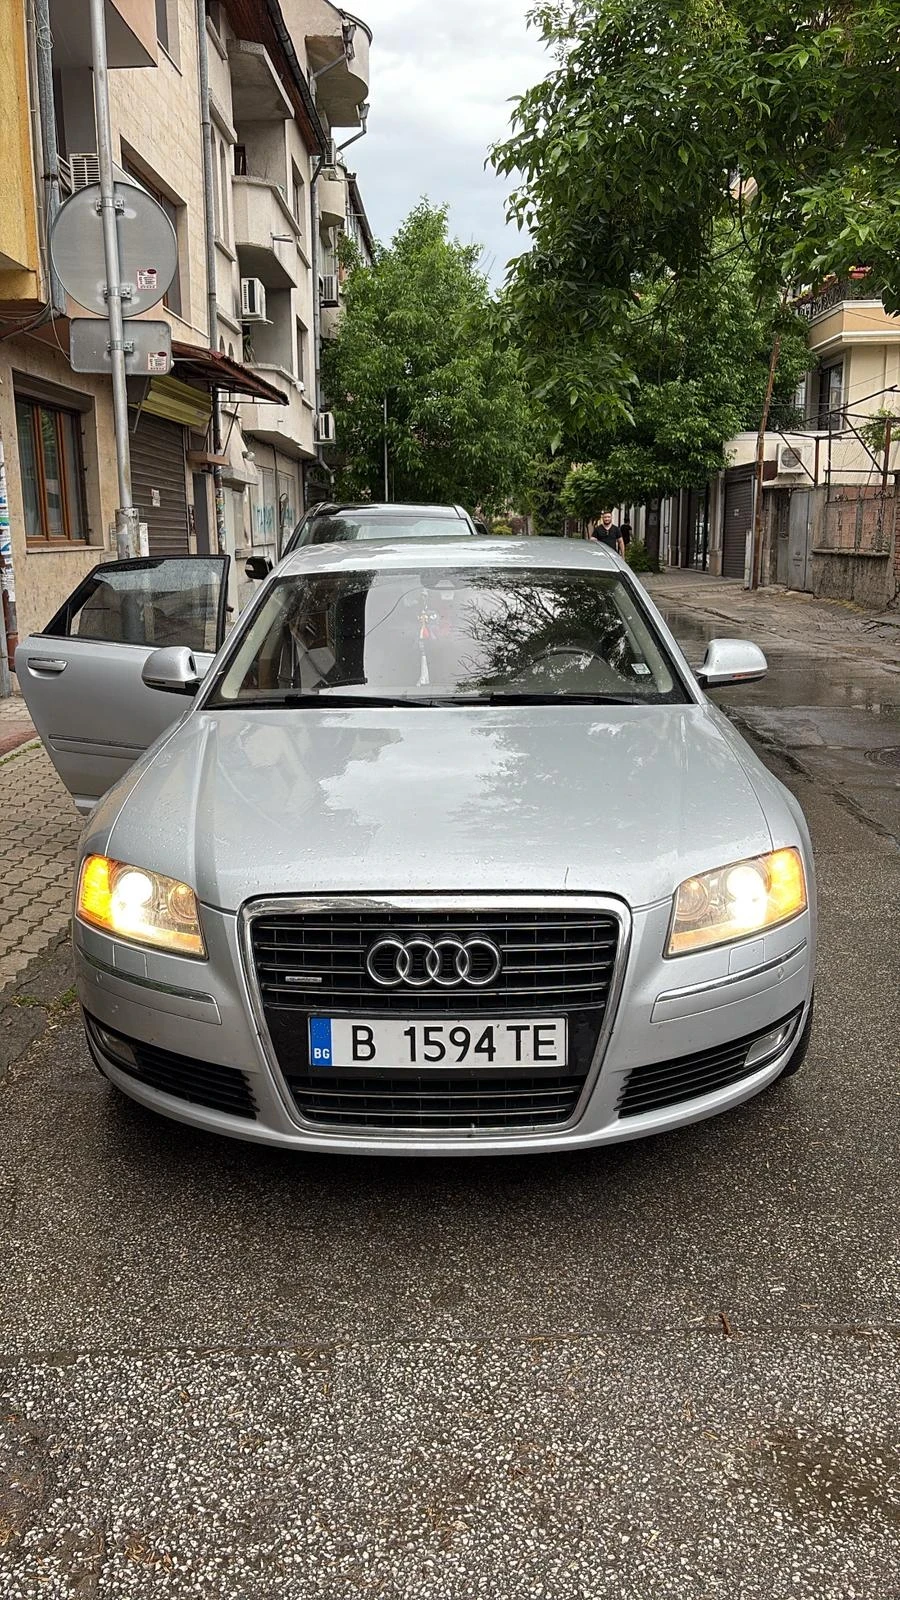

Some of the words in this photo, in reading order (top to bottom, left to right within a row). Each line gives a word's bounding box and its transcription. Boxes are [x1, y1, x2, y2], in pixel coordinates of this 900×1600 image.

[313, 1047, 330, 1059] BG
[351, 1025, 376, 1061] B
[403, 1026, 497, 1063] 1594
[506, 1024, 558, 1061] TE
